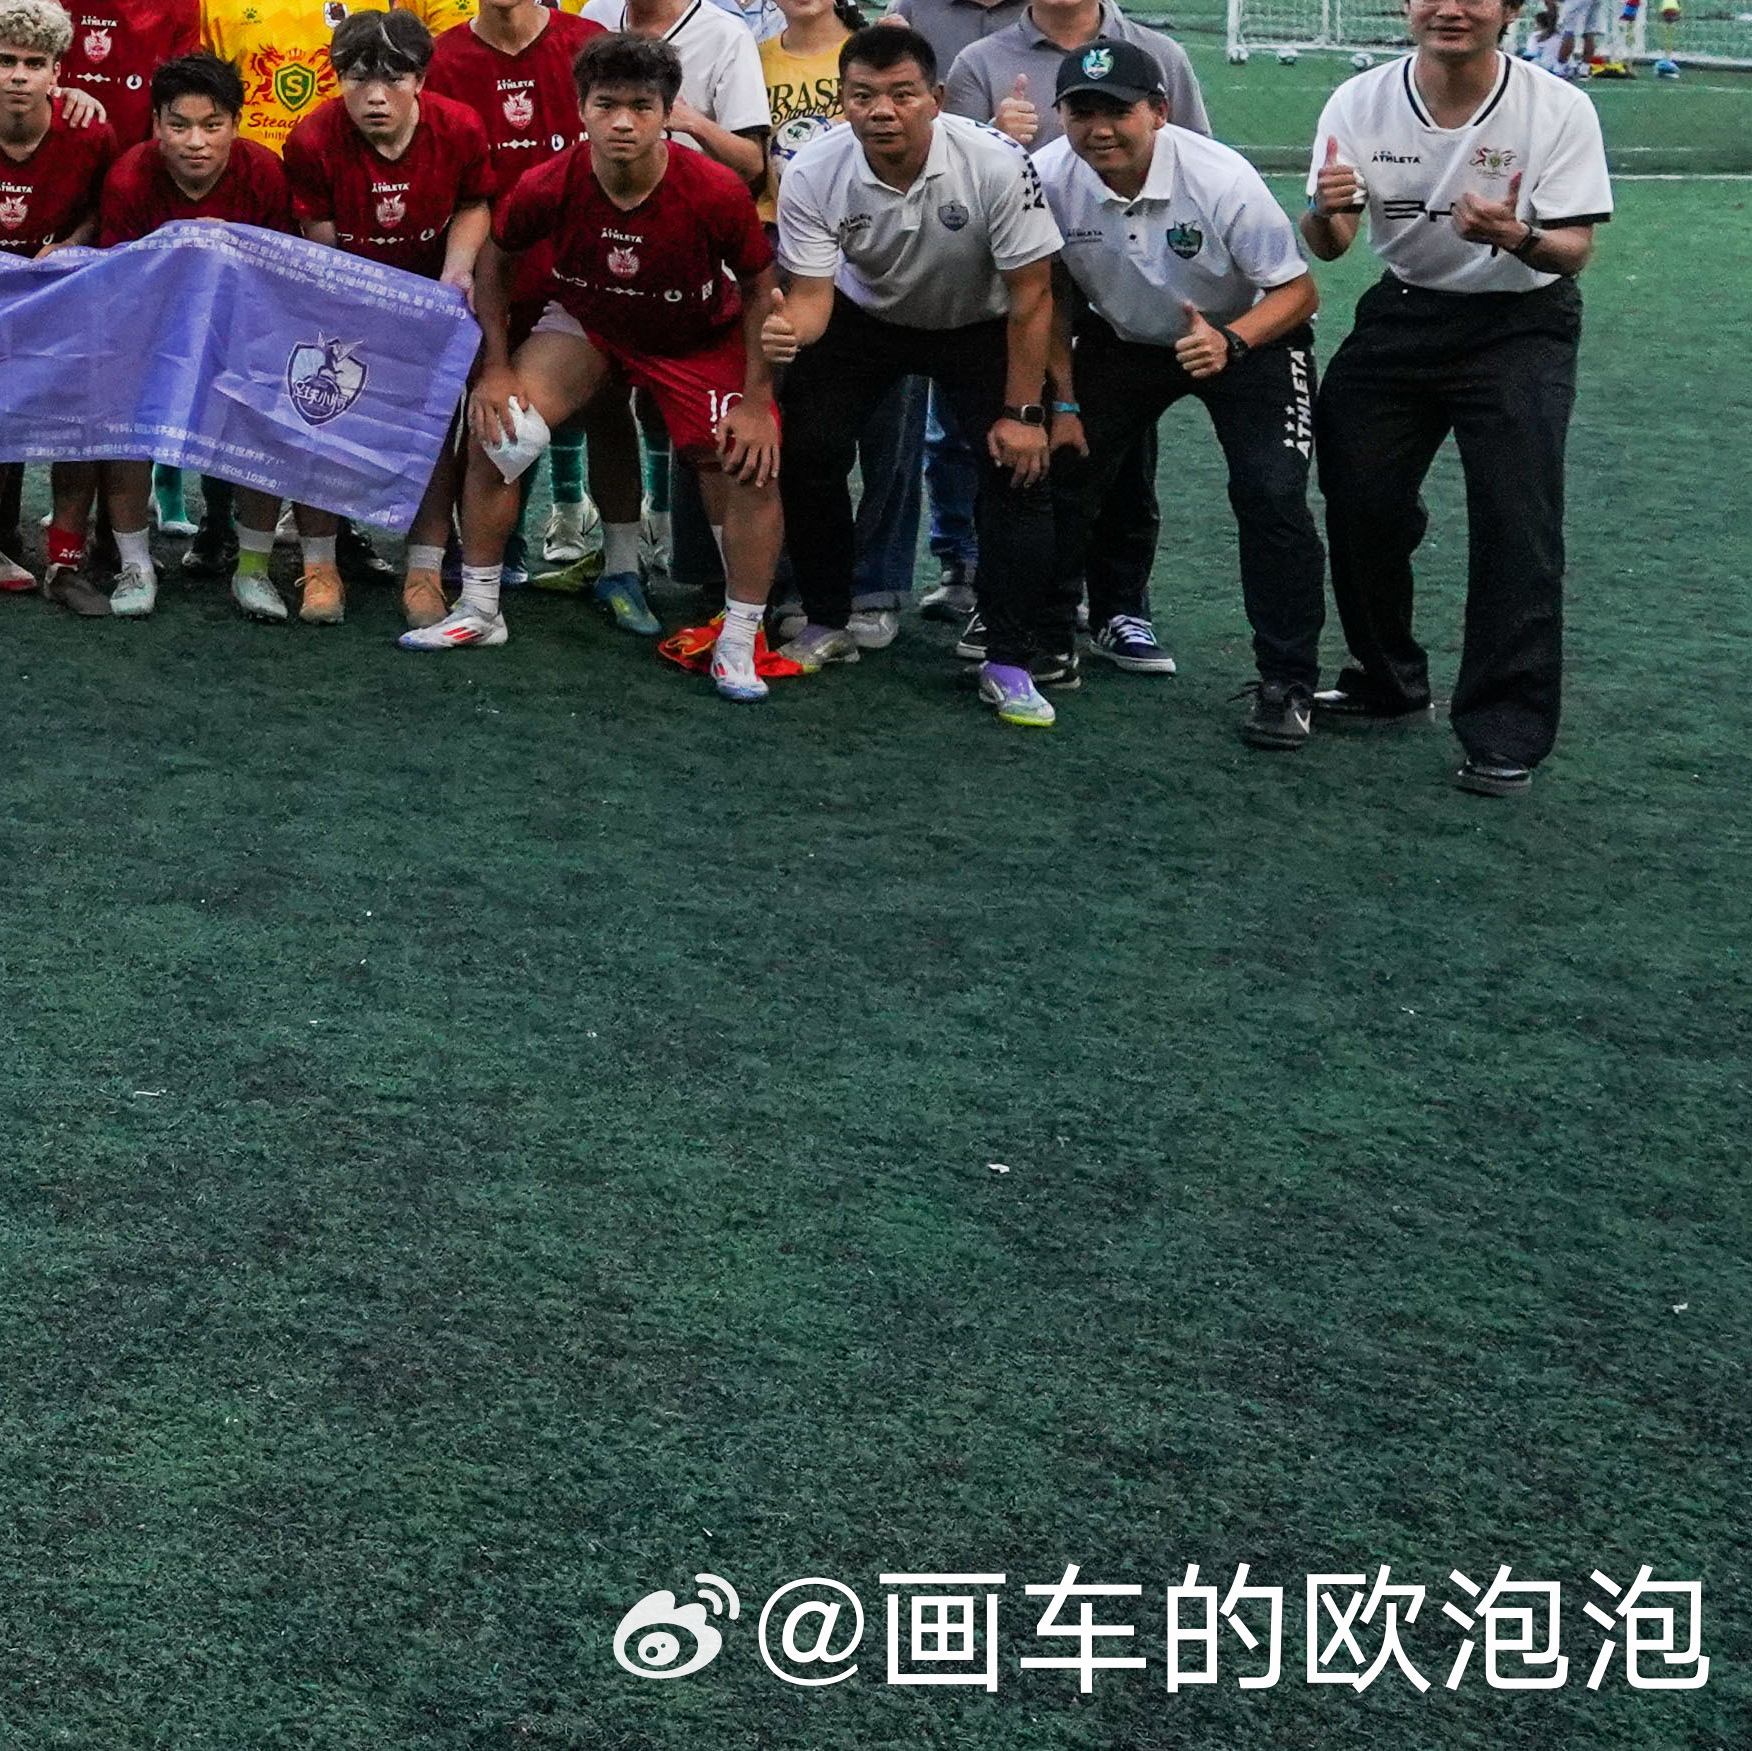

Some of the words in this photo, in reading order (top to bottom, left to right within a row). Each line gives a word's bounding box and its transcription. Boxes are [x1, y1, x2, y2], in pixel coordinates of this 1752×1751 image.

[286, 76, 303, 96] S
[247, 112, 301, 129] Stead
[1371, 153, 1422, 165] ATHLETA
[1384, 200, 1457, 222] BY
[1291, 350, 1311, 460] ATHLETA
